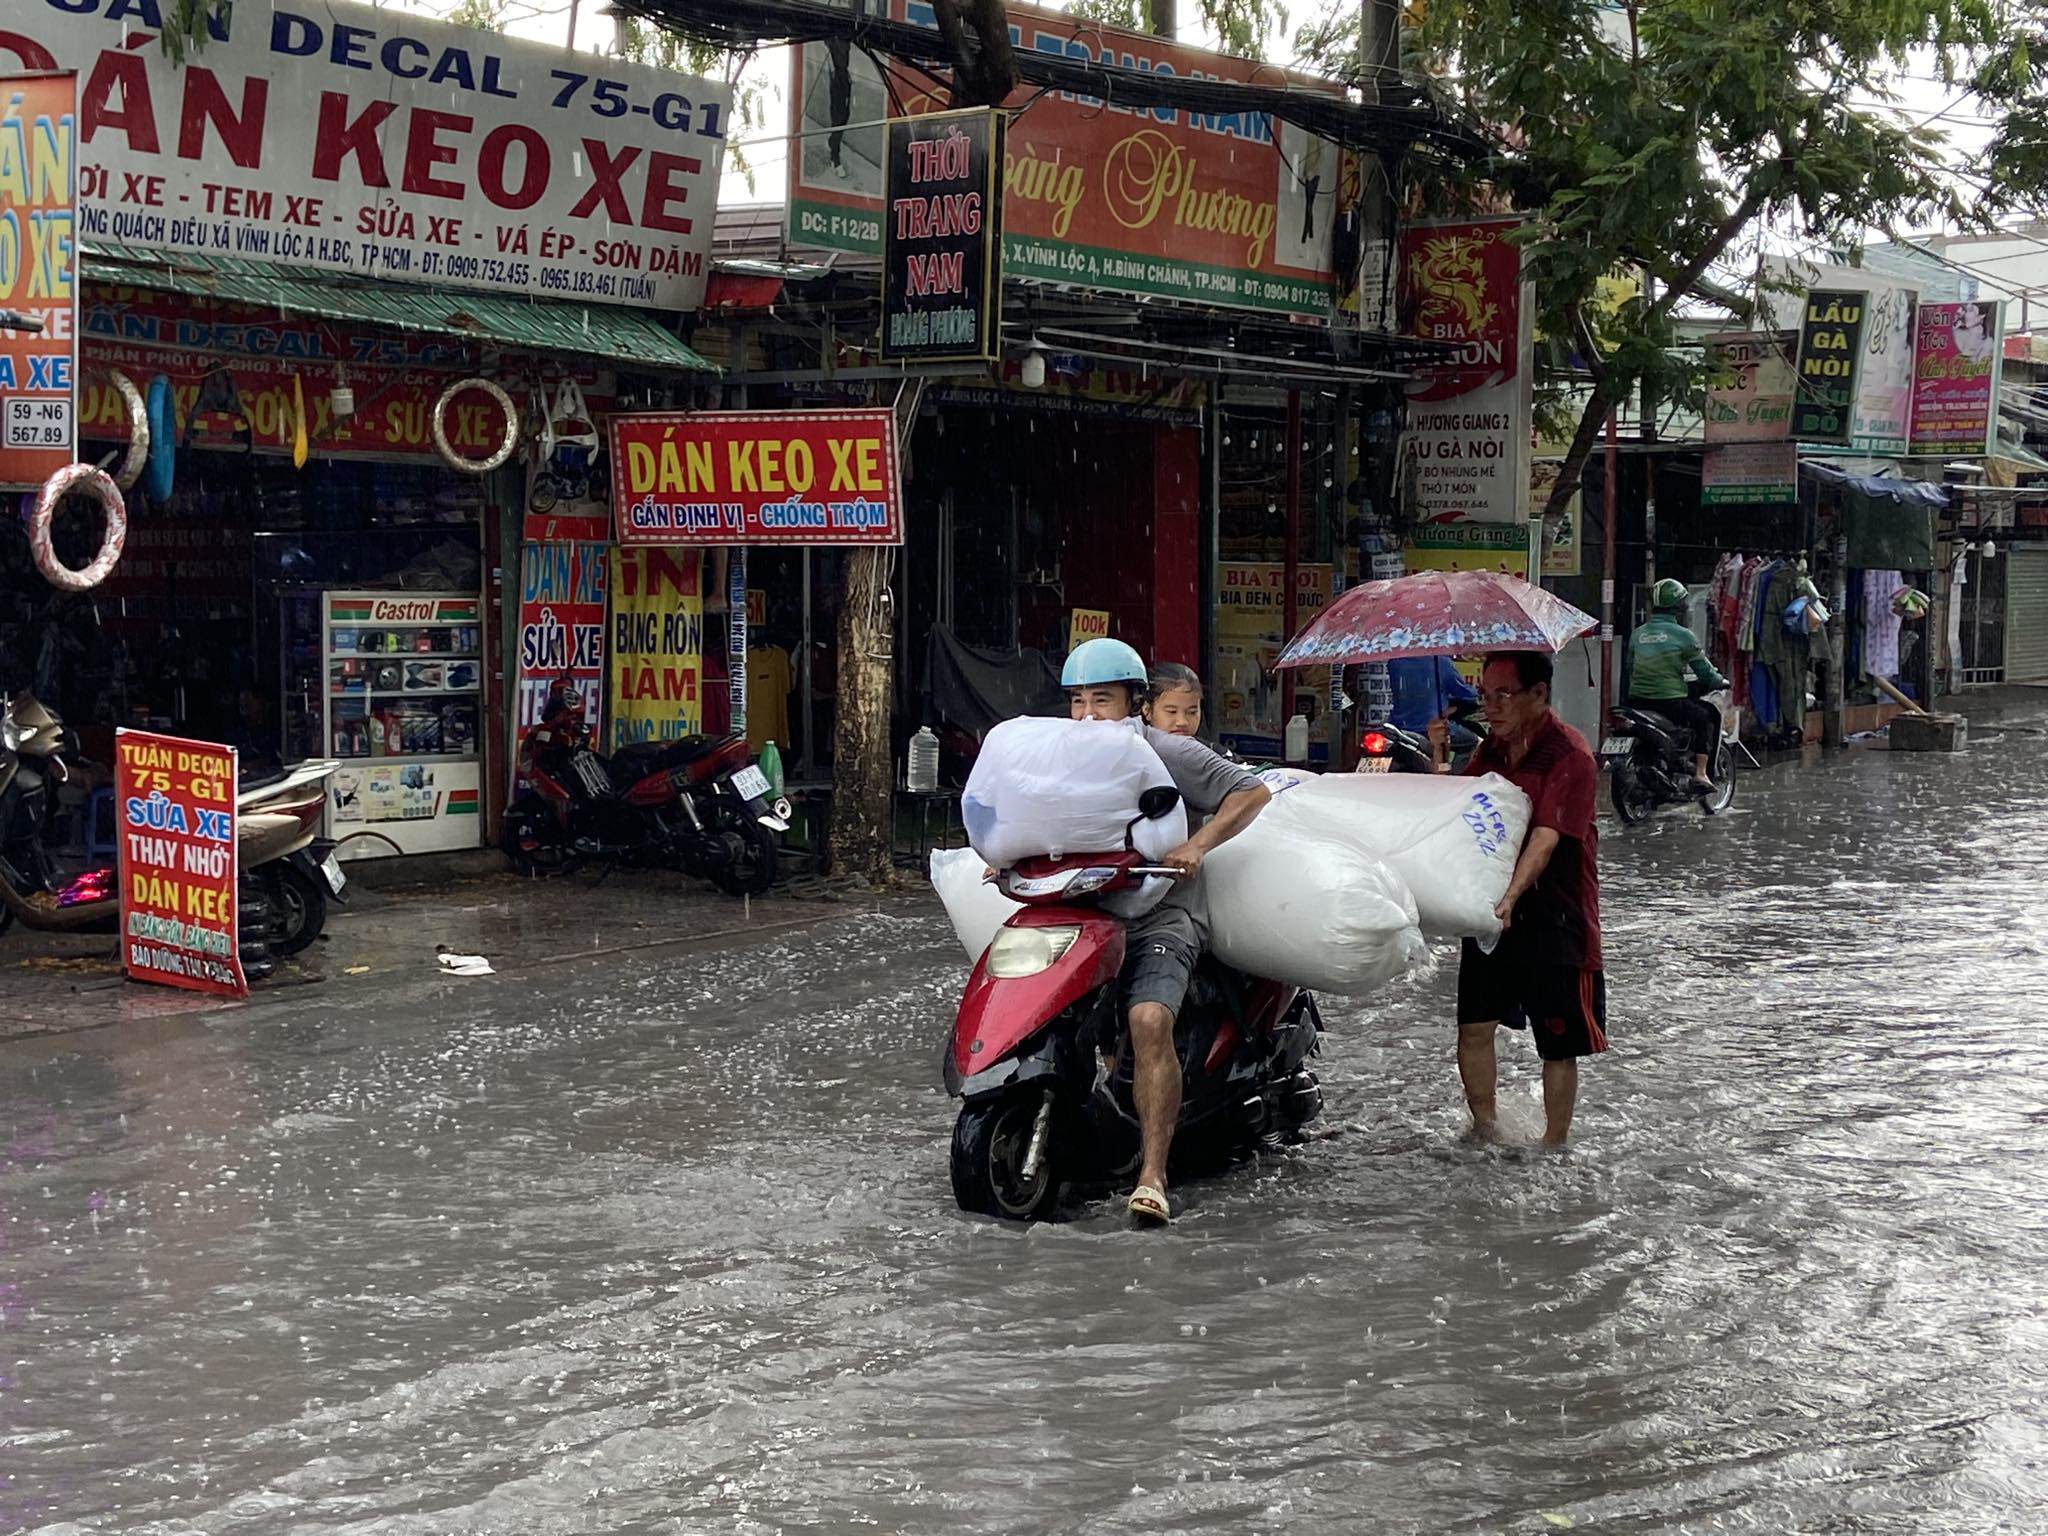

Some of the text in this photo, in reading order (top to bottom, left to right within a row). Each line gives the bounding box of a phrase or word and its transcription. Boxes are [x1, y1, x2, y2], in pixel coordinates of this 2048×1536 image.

[269, 10, 724, 139] DECAL 75-G1
[312, 90, 550, 210] KEO
[567, 137, 702, 235] XE
[908, 125, 971, 184] THỜI
[120, 172, 166, 206] XE
[202, 183, 273, 220] TEM
[282, 194, 323, 227] XE
[356, 197, 416, 241] SỬA
[425, 215, 463, 246] XE
[496, 223, 529, 256] VÁ
[539, 226, 575, 259] ÉP
[592, 239, 642, 270] SƠN
[649, 244, 702, 280] DẶM
[801, 210, 880, 242] ĐC: F12/2B
[893, 191, 982, 241] TRANG
[27, 210, 75, 299] XE
[113, 208, 165, 245] QUÁCH
[171, 216, 208, 246] ĐIÊU
[213, 220, 229, 249] XÃ
[236, 223, 269, 253] VĨNH
[273, 227, 302, 262] LỘC
[304, 236, 314, 260] A
[422, 251, 443, 275] ĐT:
[446, 253, 530, 286] 0909.752.455
[540, 266, 617, 296] 0965.183.461
[619, 271, 657, 303] (TUẤN)
[905, 251, 965, 297] NAM
[1060, 247, 1086, 273] LỘC
[1103, 255, 1145, 281] H.BÌNH
[1148, 266, 1192, 291] CHÁNH,
[1195, 270, 1236, 293] TP.HCM
[1433, 322, 1467, 339] BIA
[1808, 298, 1861, 324] LẨU
[175, 318, 328, 361] DECAL
[1812, 329, 1849, 350] GÀ
[26, 356, 72, 391] XE
[1803, 355, 1851, 377] NÒI
[13, 404, 32, 420] 59
[454, 404, 490, 447] XE
[1463, 413, 1501, 431] GIANG
[1502, 414, 1510, 430] 2
[11, 426, 63, 444] 567.89
[1436, 436, 1463, 459] GÀ
[1468, 436, 1504, 459] NÒI
[626, 427, 884, 494] DÁN KEO XE
[632, 494, 888, 534] GẮN ĐỊNH VỊ CHỐNG TRỘM
[1468, 526, 1513, 546] Giang
[1515, 525, 1527, 543] 2
[575, 545, 604, 605] XE
[1226, 569, 1320, 588] BIA TƠI
[374, 600, 435, 621] Castrol
[1220, 591, 1243, 605] BIA
[663, 601, 701, 656] RÔN
[1074, 614, 1106, 634] 100k
[573, 624, 603, 669] XE
[621, 658, 697, 702] LÀM
[121, 742, 173, 770] TUẤN
[130, 769, 228, 802] 75 G1
[127, 791, 232, 843] SỬA XE
[127, 833, 178, 869] THAY
[132, 870, 180, 912] DÁN
